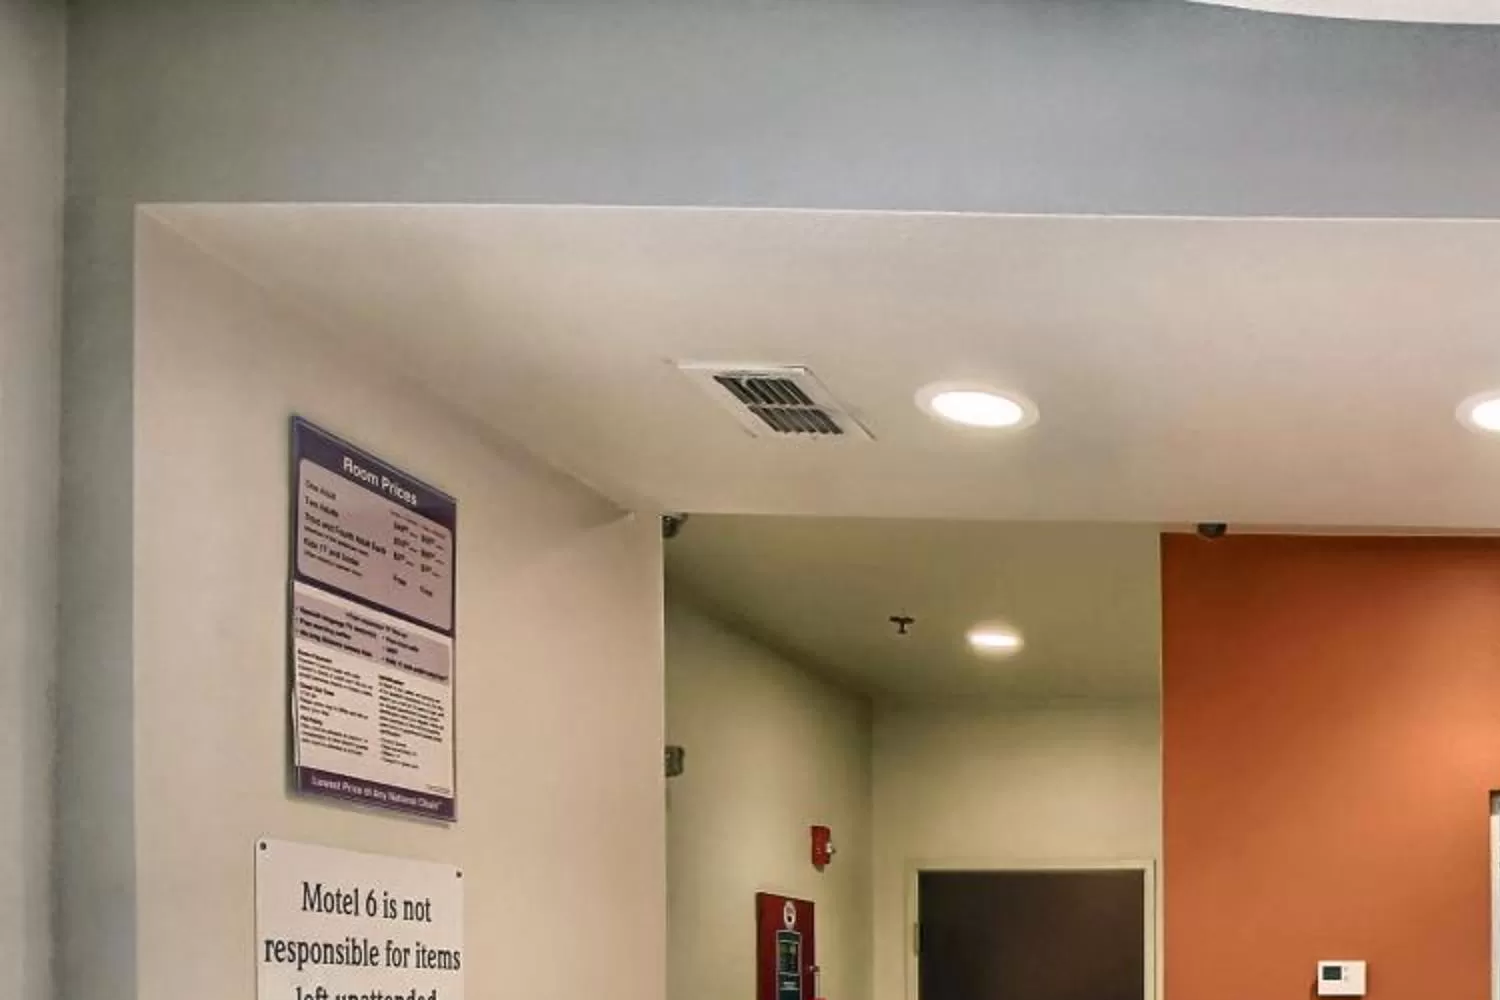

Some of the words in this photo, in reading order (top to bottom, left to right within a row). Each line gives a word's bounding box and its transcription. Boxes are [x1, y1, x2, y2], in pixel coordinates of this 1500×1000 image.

[343, 456, 380, 488] Room
[381, 474, 418, 507] Prices
[301, 881, 359, 917] Motel
[366, 889, 377, 918] 6
[383, 891, 397, 921] is
[403, 897, 432, 923] not
[264, 937, 381, 971] responsible
[385, 940, 411, 969] for
[415, 941, 461, 971] items
